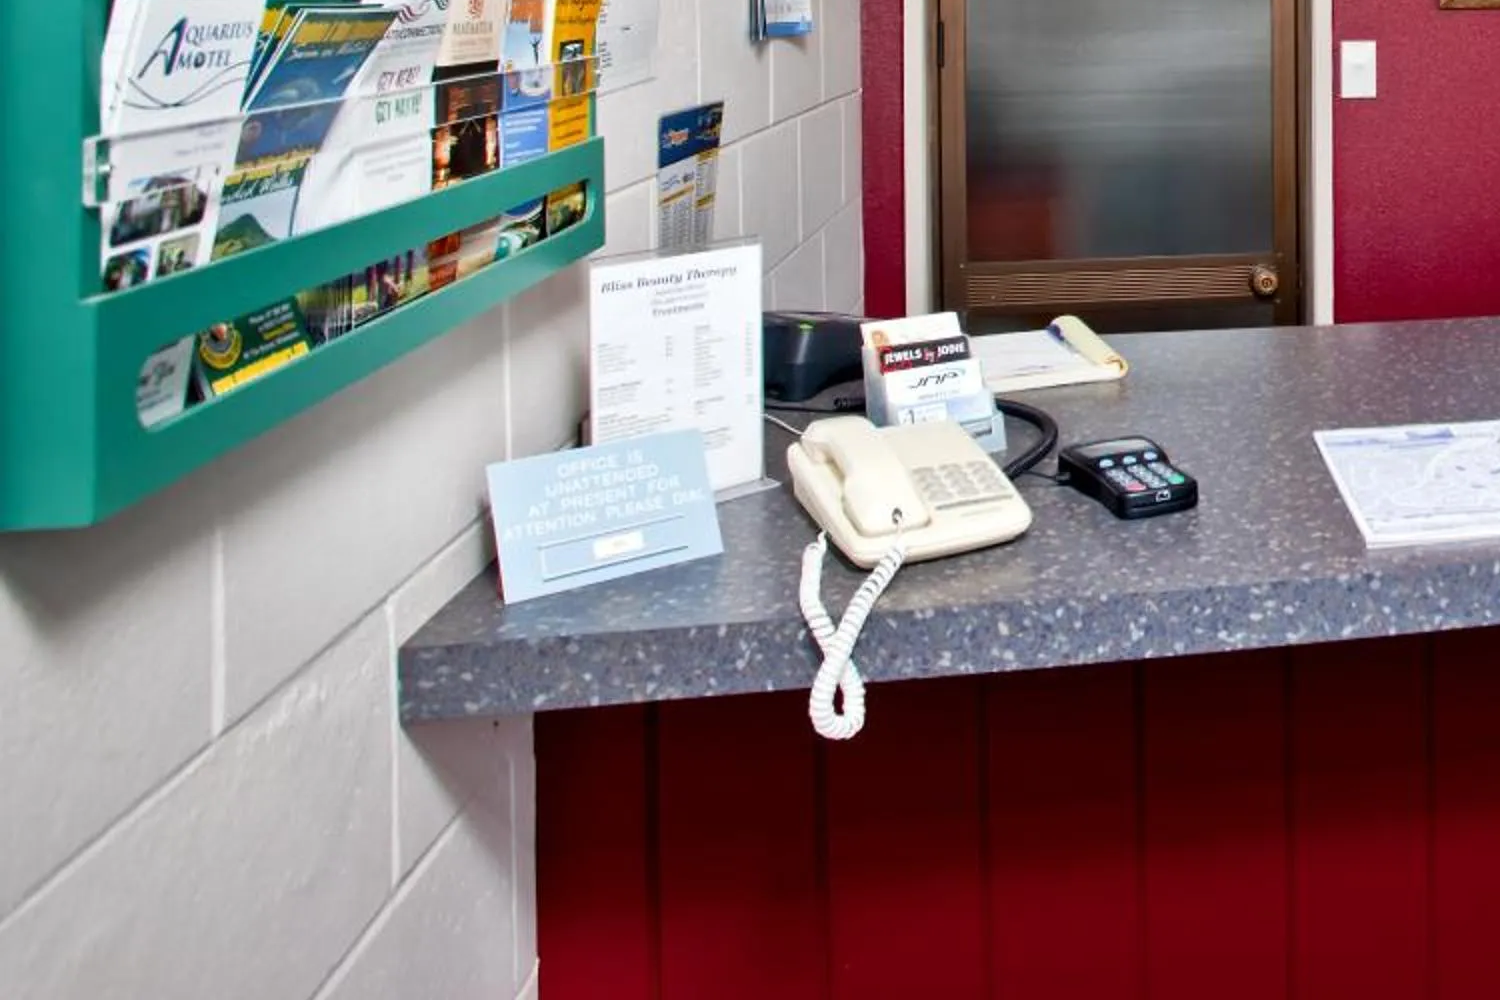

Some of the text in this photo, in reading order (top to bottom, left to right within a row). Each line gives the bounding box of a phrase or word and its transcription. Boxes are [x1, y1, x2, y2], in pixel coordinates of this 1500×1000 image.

[177, 50, 231, 70] MOTEL
[637, 273, 684, 289] Beauty
[686, 265, 738, 282] Therapy
[884, 347, 923, 365] JEWELS
[937, 341, 967, 358] JODIE
[557, 448, 644, 478] OFFICE IS
[544, 463, 660, 498] UNATTENDED
[528, 475, 681, 518] AT PRESENT FOR
[504, 511, 597, 541] ATTENTION
[606, 496, 665, 520] PLEASE
